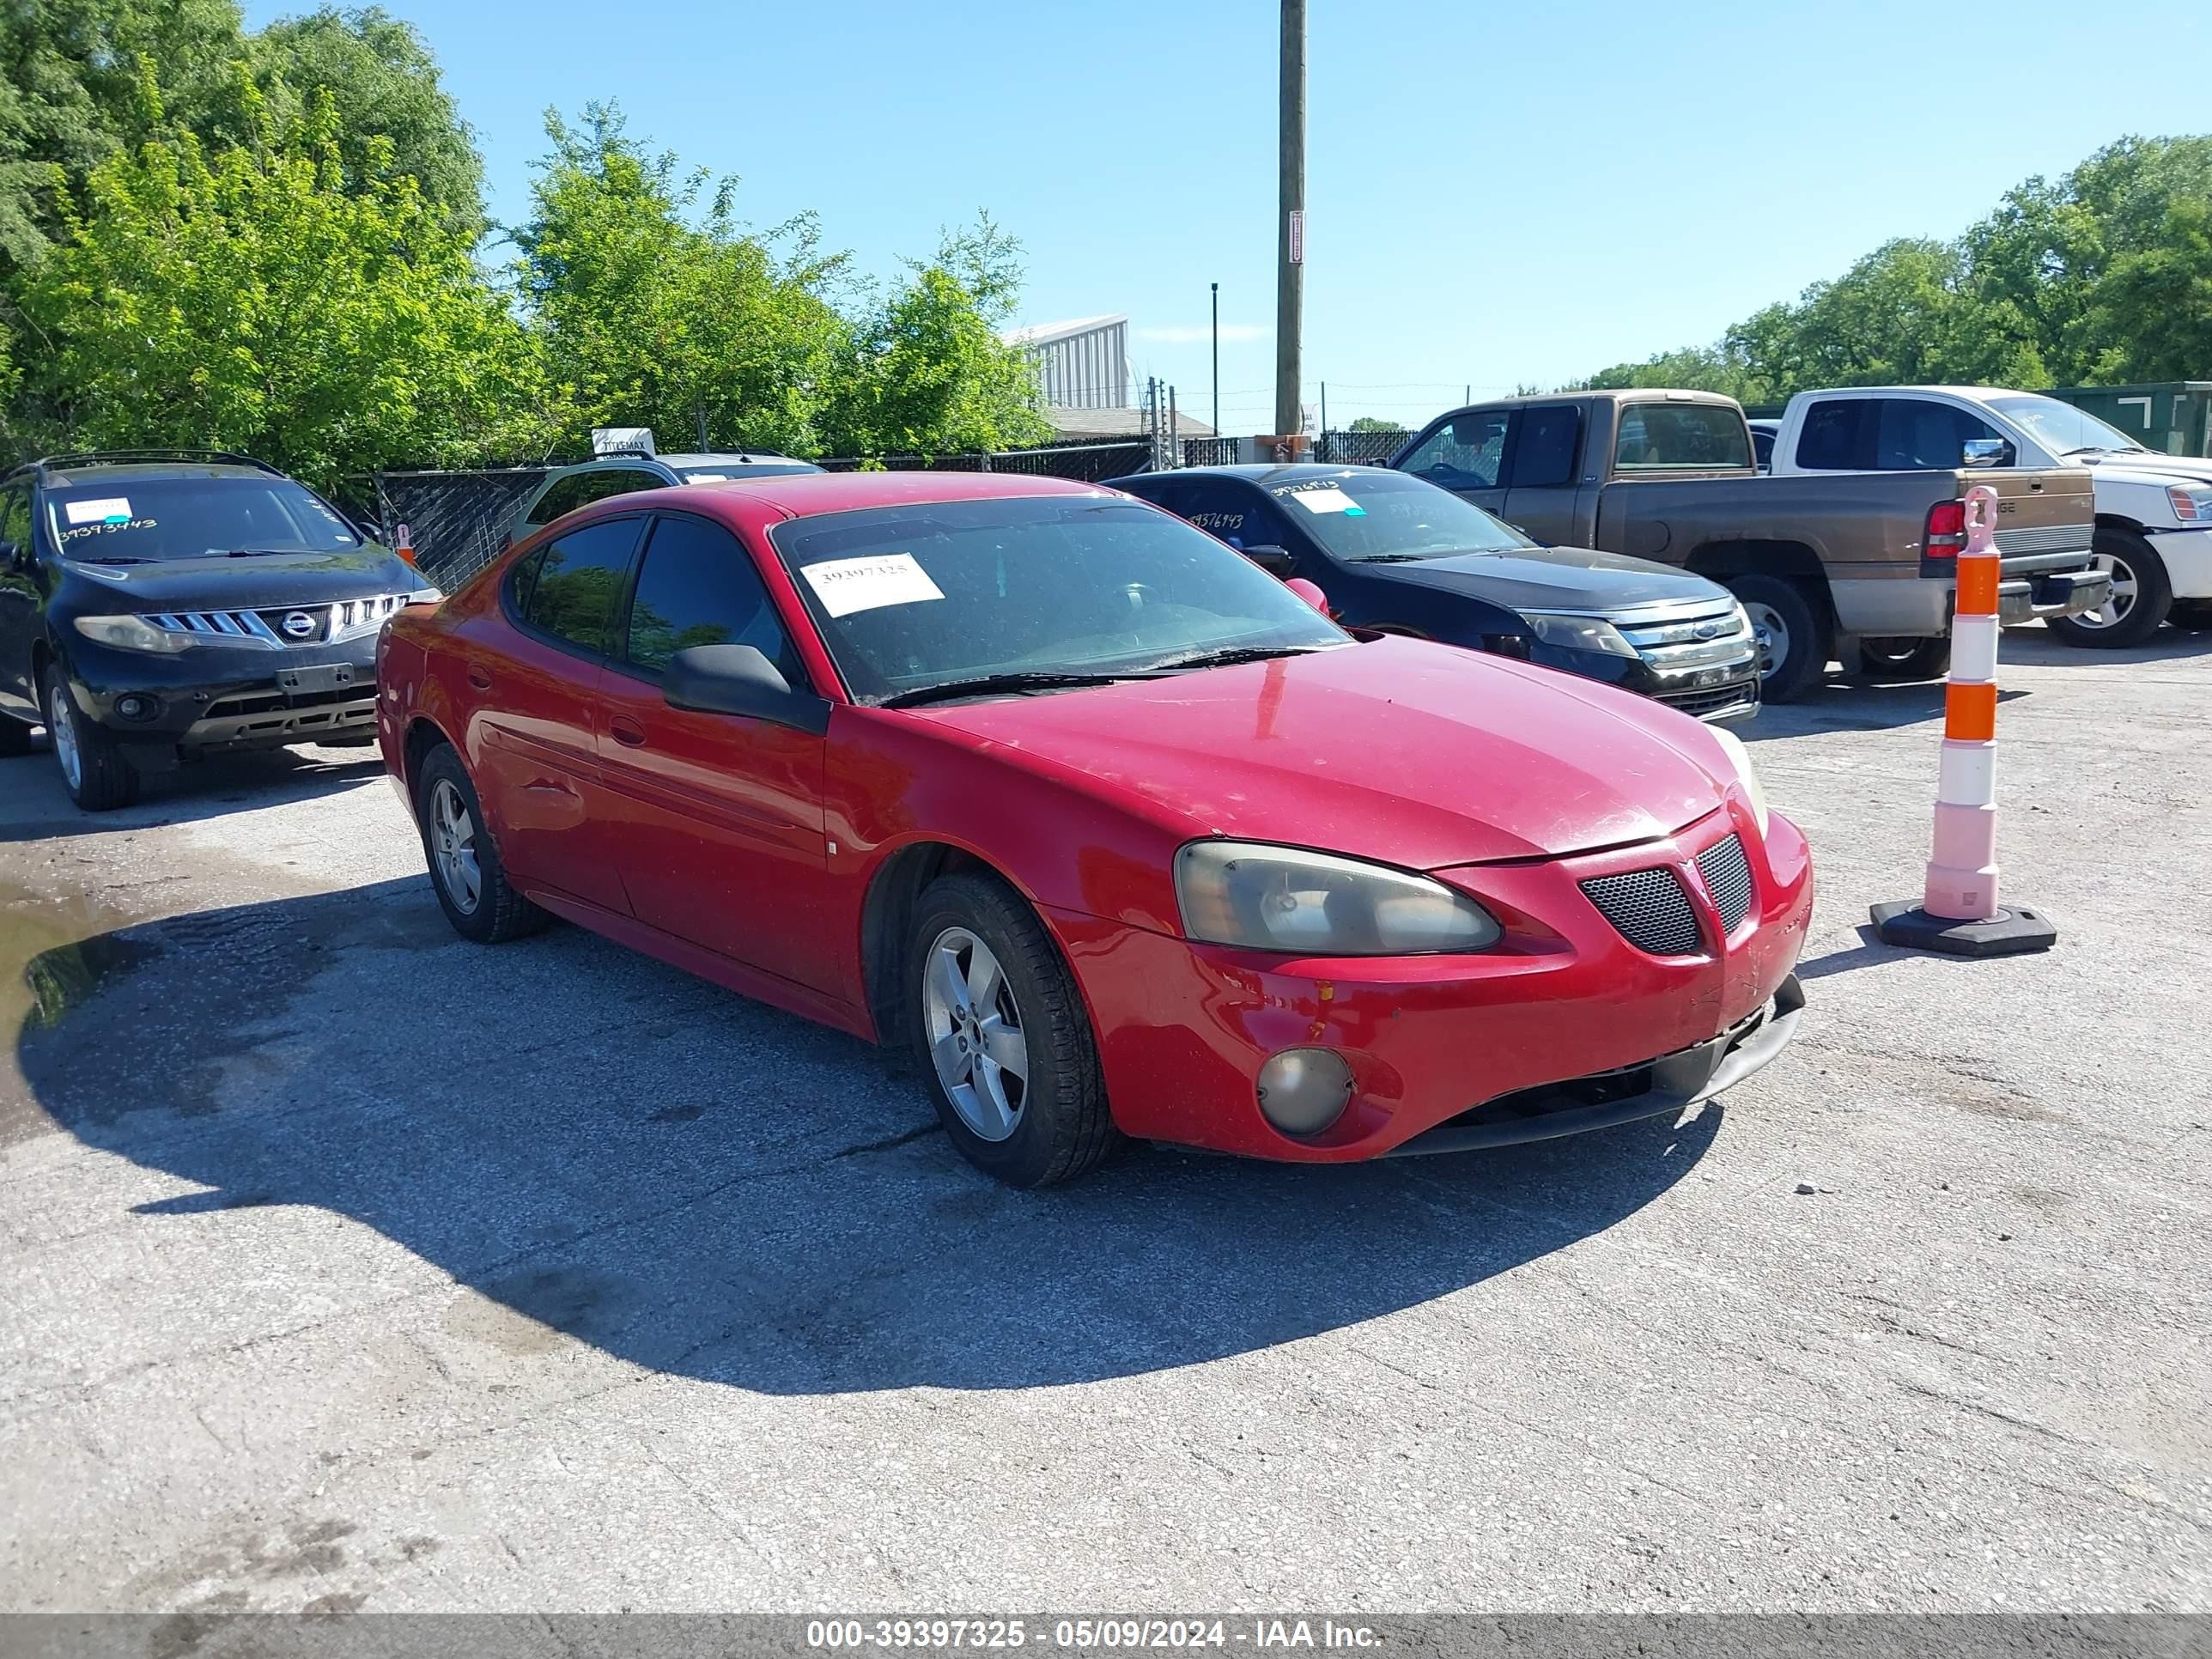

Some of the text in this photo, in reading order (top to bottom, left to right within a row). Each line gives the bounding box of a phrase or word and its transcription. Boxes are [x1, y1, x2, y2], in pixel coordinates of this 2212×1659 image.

[603, 441, 646, 451] TITLEMAX
[1271, 481, 1340, 496] 39376943
[58, 520, 157, 543] 39393443
[822, 565, 907, 584] 39397325
